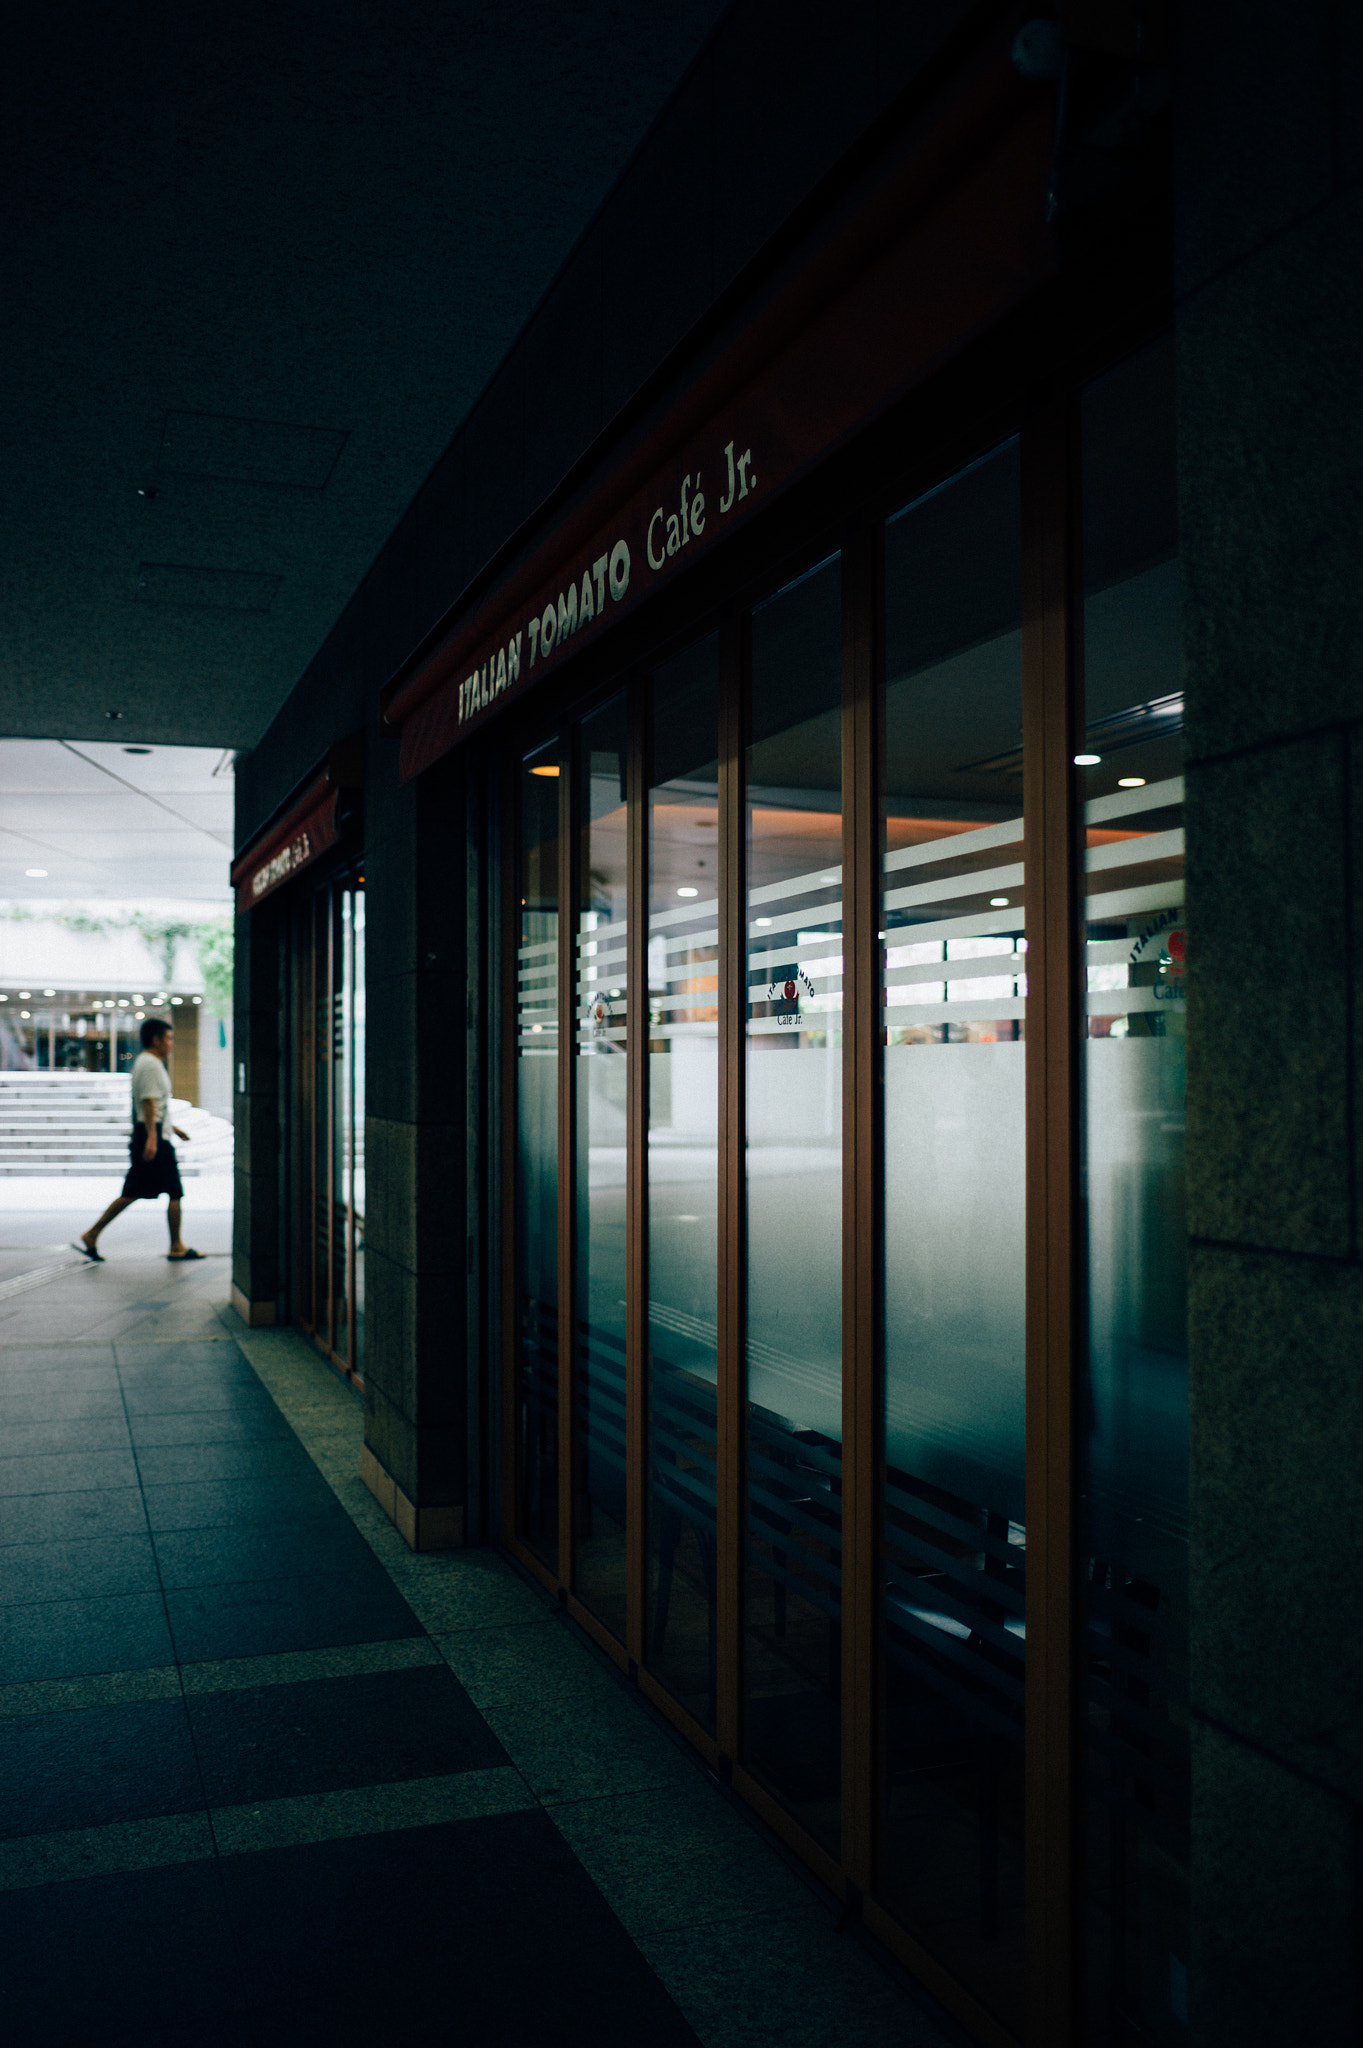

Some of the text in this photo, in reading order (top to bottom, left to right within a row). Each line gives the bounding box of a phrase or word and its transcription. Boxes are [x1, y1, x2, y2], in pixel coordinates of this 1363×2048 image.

[458, 440, 757, 726] ITALIAN TOMATO Café Jr.
[1130, 907, 1178, 962] ITALIAN
